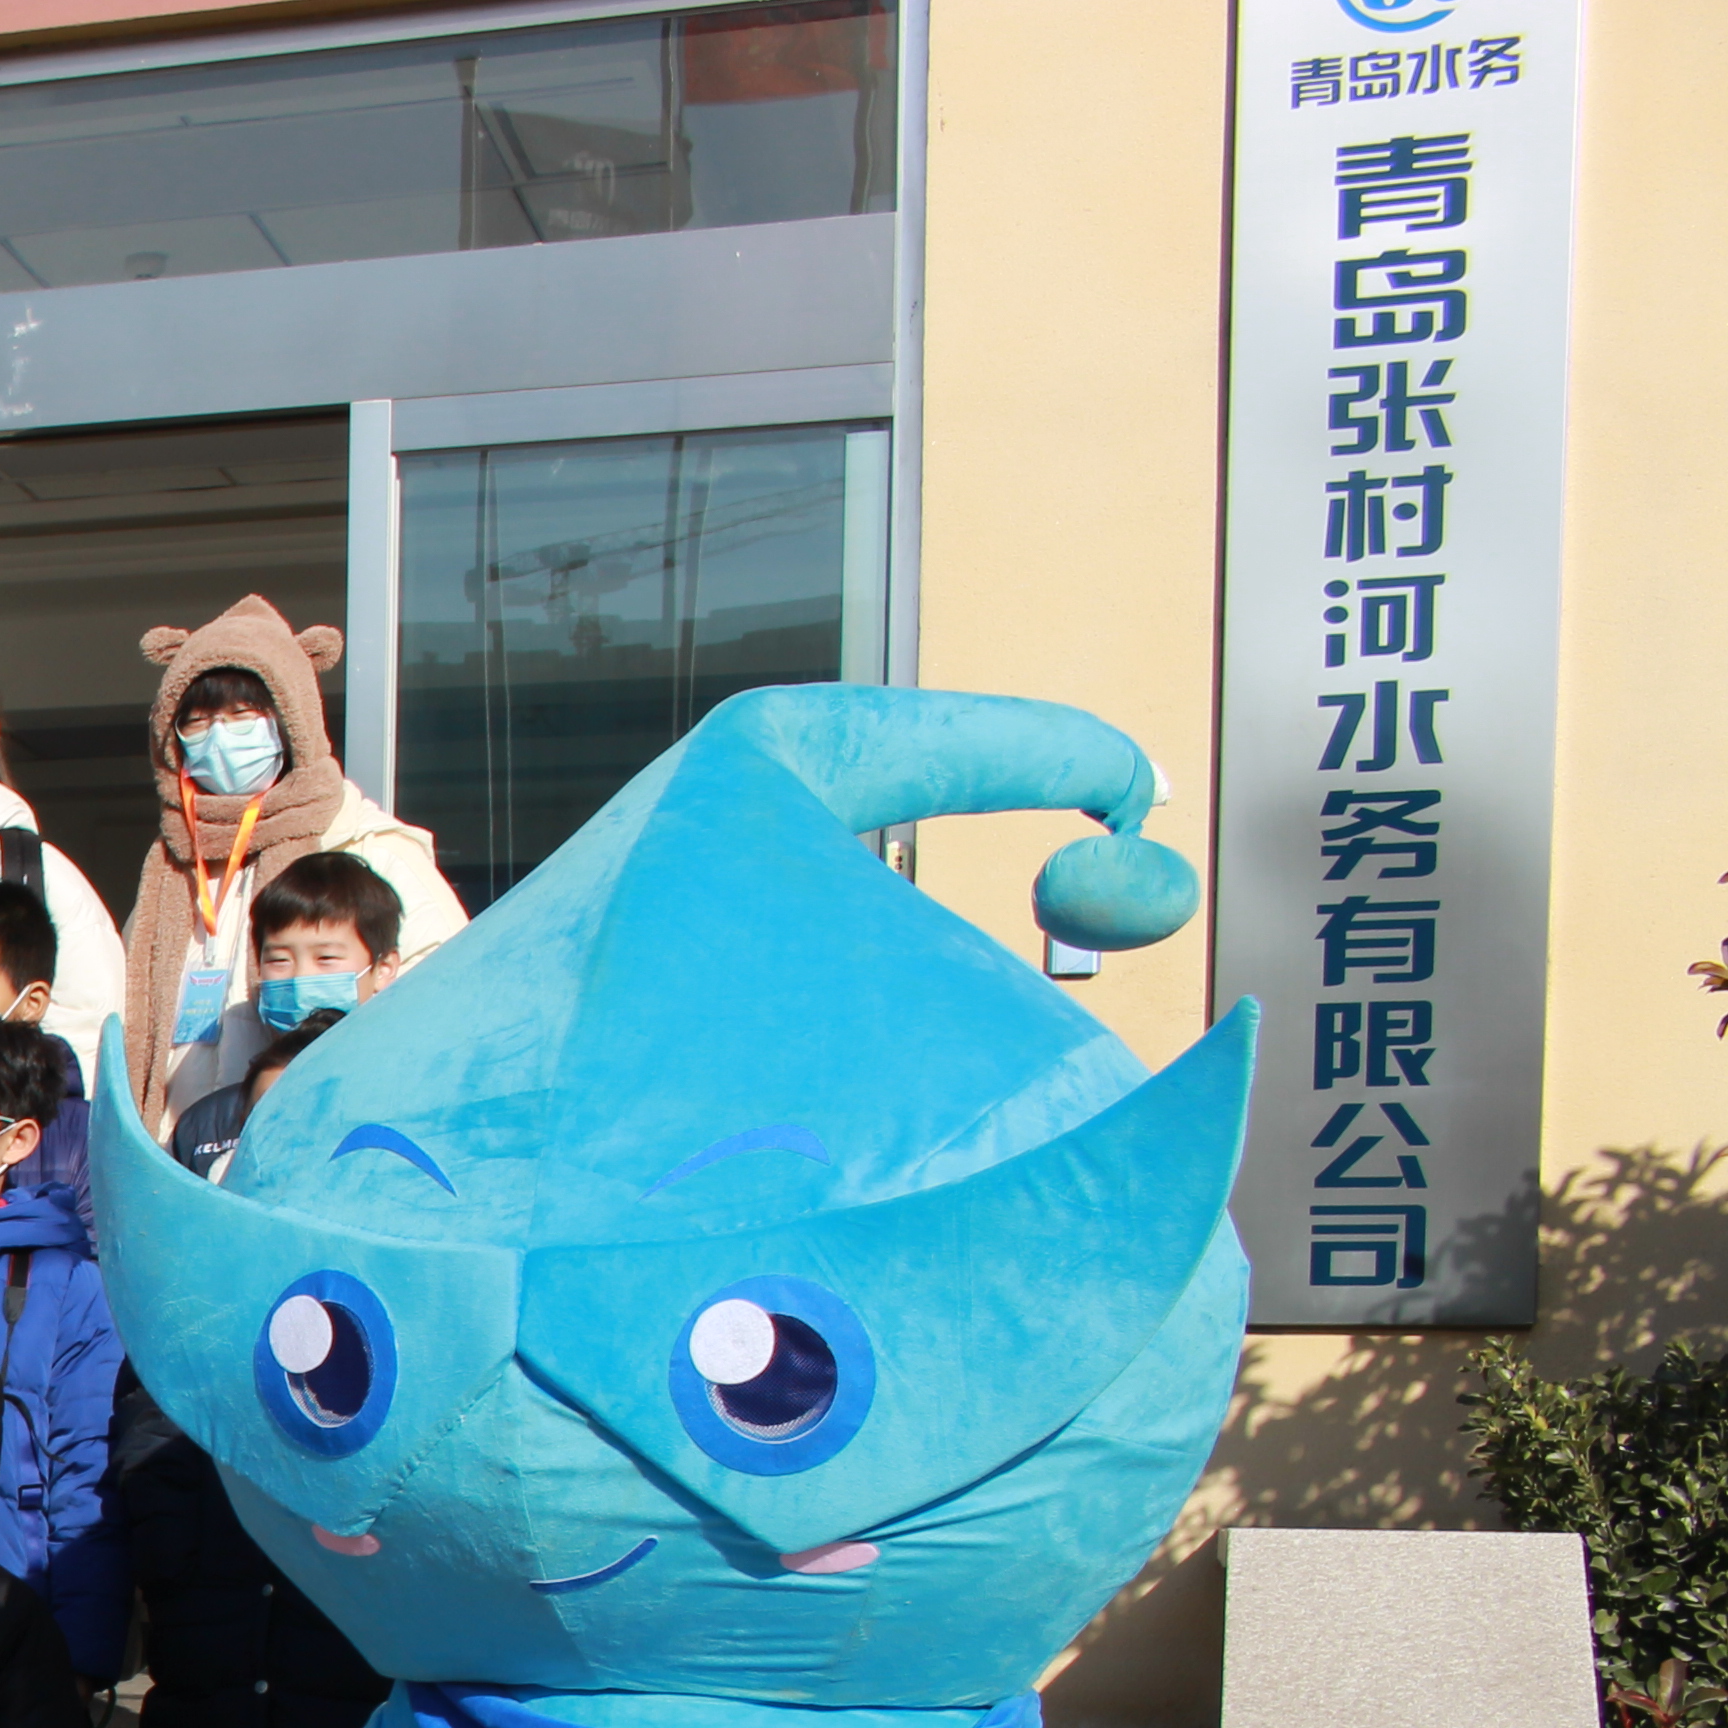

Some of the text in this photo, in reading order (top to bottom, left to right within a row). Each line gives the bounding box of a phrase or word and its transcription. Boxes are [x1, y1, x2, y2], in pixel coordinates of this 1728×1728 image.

[1290, 35, 1522, 109] 青岛水务
[1309, 132, 1475, 1290] 青岛张村河水务有限公司
